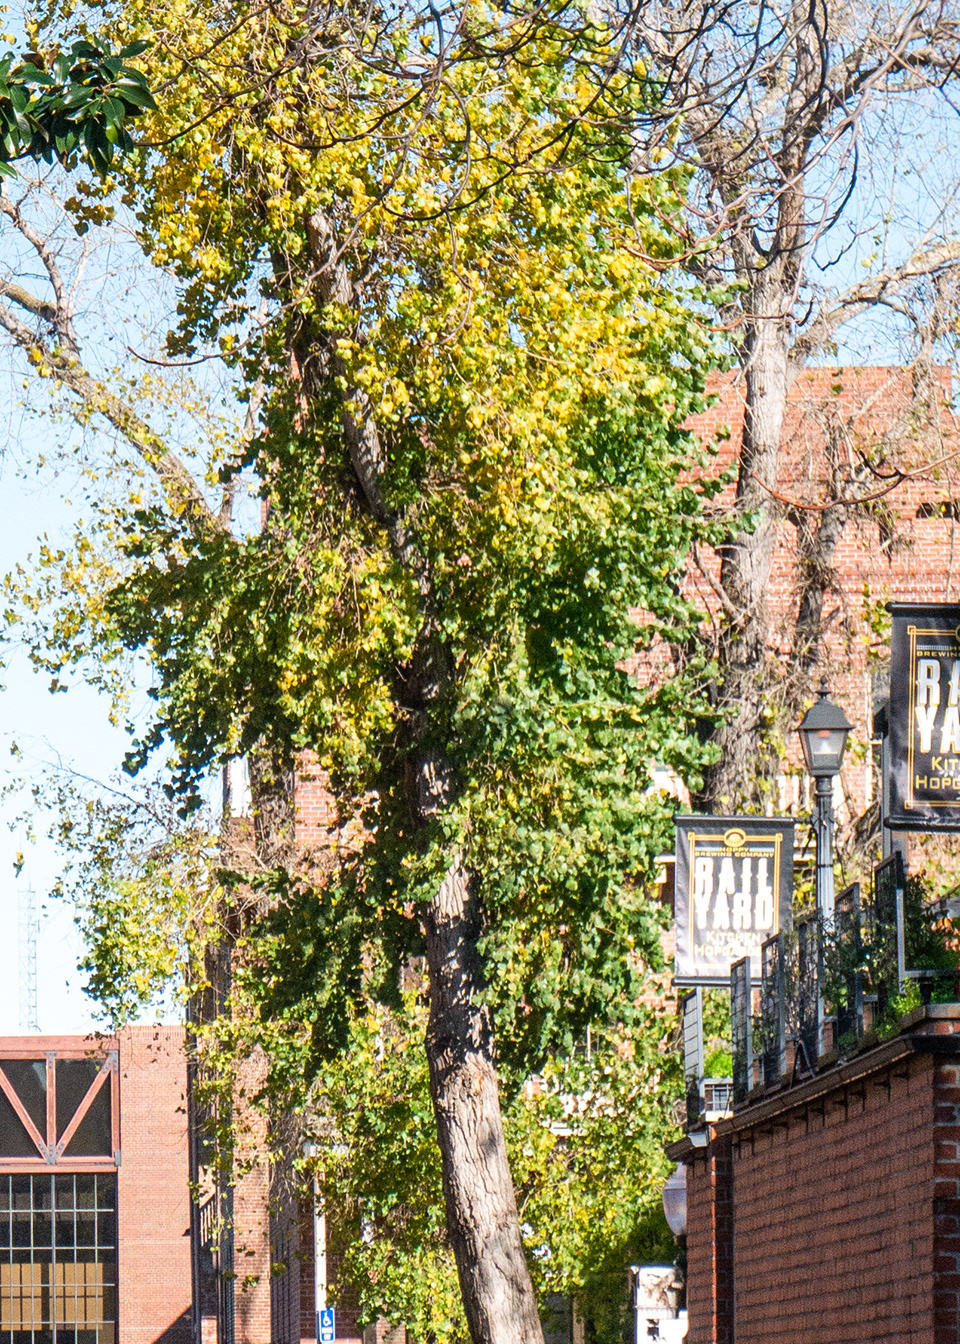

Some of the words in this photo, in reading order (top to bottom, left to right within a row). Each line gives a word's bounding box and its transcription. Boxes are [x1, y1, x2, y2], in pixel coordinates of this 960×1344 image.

[932, 756, 960, 771] KIT
[694, 857, 773, 894] RAIL
[694, 893, 774, 930] YARD
[706, 930, 761, 944] KITCHEN
